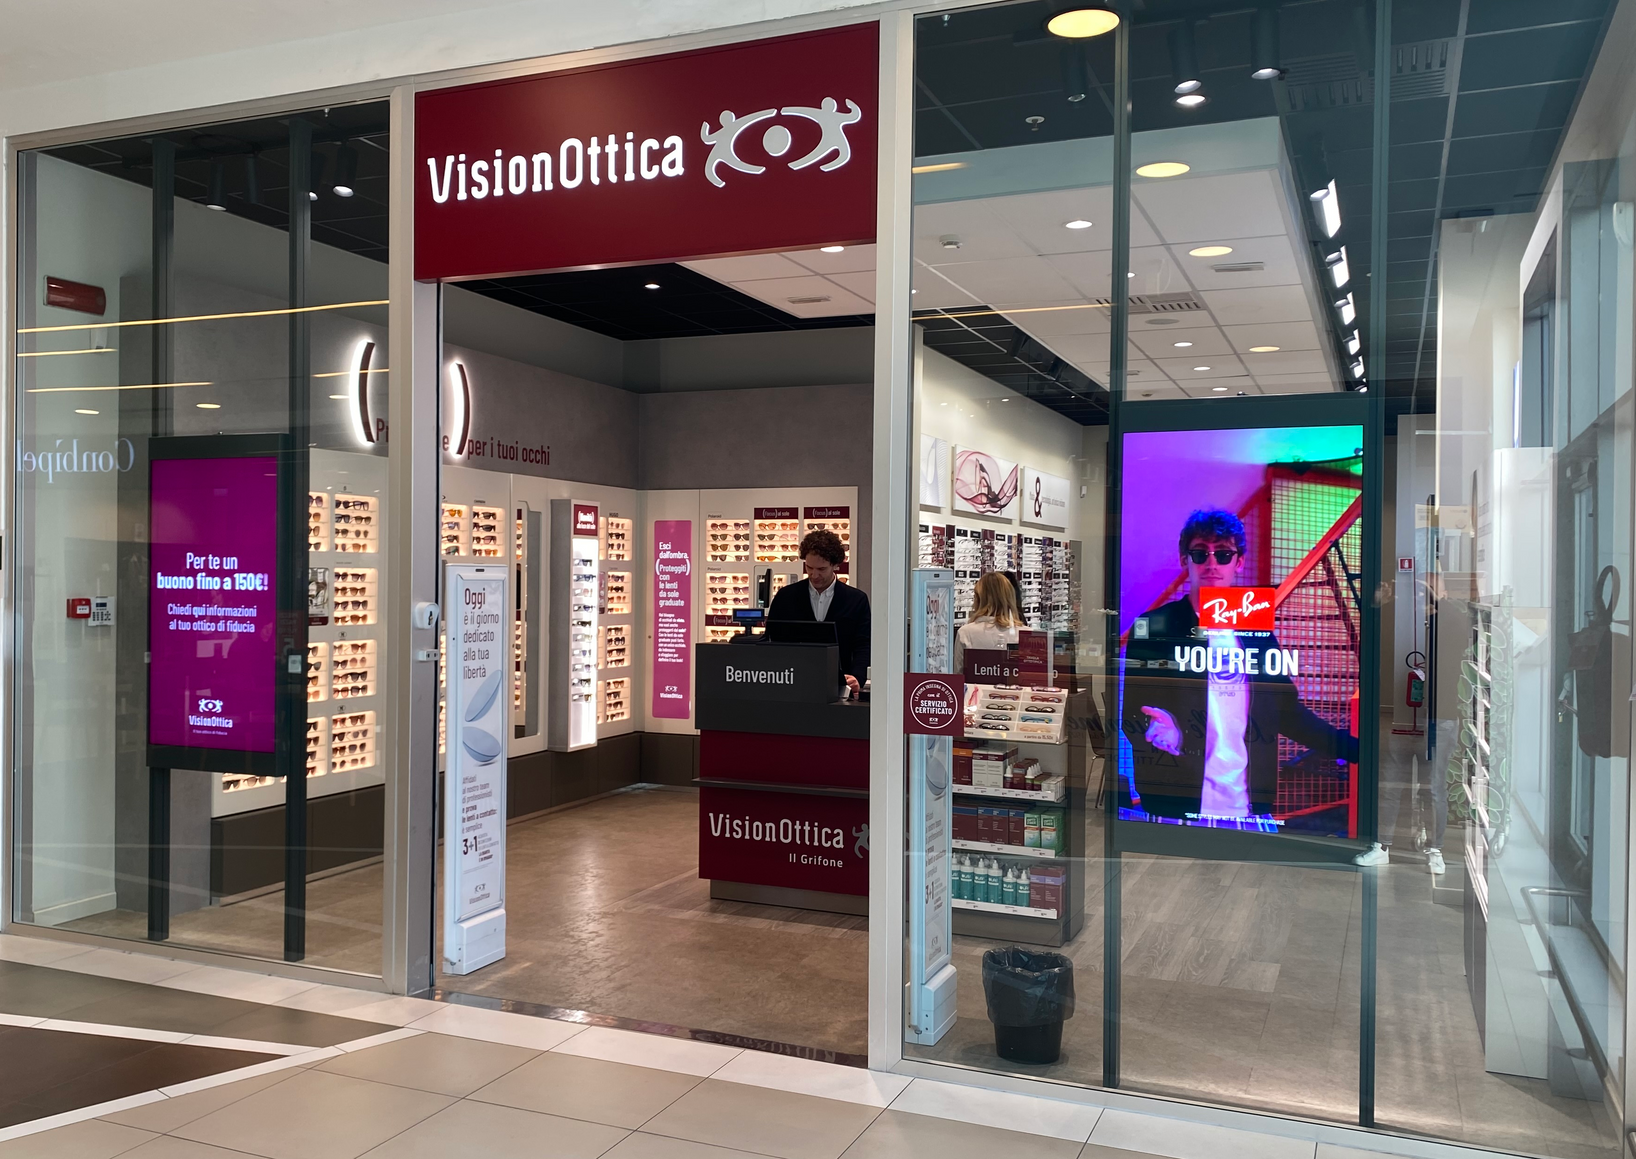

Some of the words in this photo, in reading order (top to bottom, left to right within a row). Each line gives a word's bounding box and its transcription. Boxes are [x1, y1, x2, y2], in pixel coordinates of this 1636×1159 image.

[427, 131, 685, 203] VisionOttica
[467, 438, 487, 460] per
[490, 437, 494, 458] i
[497, 441, 518, 462] tuoi
[522, 445, 550, 466] occhi
[659, 541, 671, 550] Esci
[186, 552, 205, 569] Per
[208, 553, 220, 569] te
[222, 556, 238, 570] un
[156, 571, 194, 589] buono
[196, 572, 221, 590] fino
[222, 576, 232, 590] a
[233, 572, 268, 591] 150€!
[665, 581, 678, 589] lenti
[464, 588, 486, 609] Oggi
[667, 590, 679, 598] sole
[167, 603, 192, 615] Chiedi
[192, 604, 206, 618] qui
[206, 604, 257, 617] informazioni
[659, 598, 685, 608] graduate
[1203, 591, 1270, 624] Ray-Ban
[169, 619, 176, 630] al
[178, 619, 191, 631] tuo
[192, 620, 215, 632] ottico
[217, 620, 225, 632] di
[226, 620, 255, 633] fiducia
[464, 612, 468, 625] è
[470, 611, 475, 625] il
[476, 611, 499, 627] giorno
[463, 629, 494, 643] dedicato
[463, 647, 476, 661] alla
[478, 648, 489, 660] tua
[1174, 645, 1260, 675] YOU'RE
[1265, 648, 1299, 676] ON
[463, 664, 486, 680] libertà
[725, 665, 794, 685] Benvenuti
[974, 663, 1001, 676] Lenti
[1003, 668, 1010, 677] a
[914, 706, 953, 715] CERTIFICATO
[920, 700, 947, 708] SERVIZIO
[188, 715, 233, 728] VisionOttica
[709, 812, 844, 849] VisionOttica
[462, 835, 477, 855] 3+1
[789, 853, 796, 863] Il
[800, 854, 843, 868] Grifone
